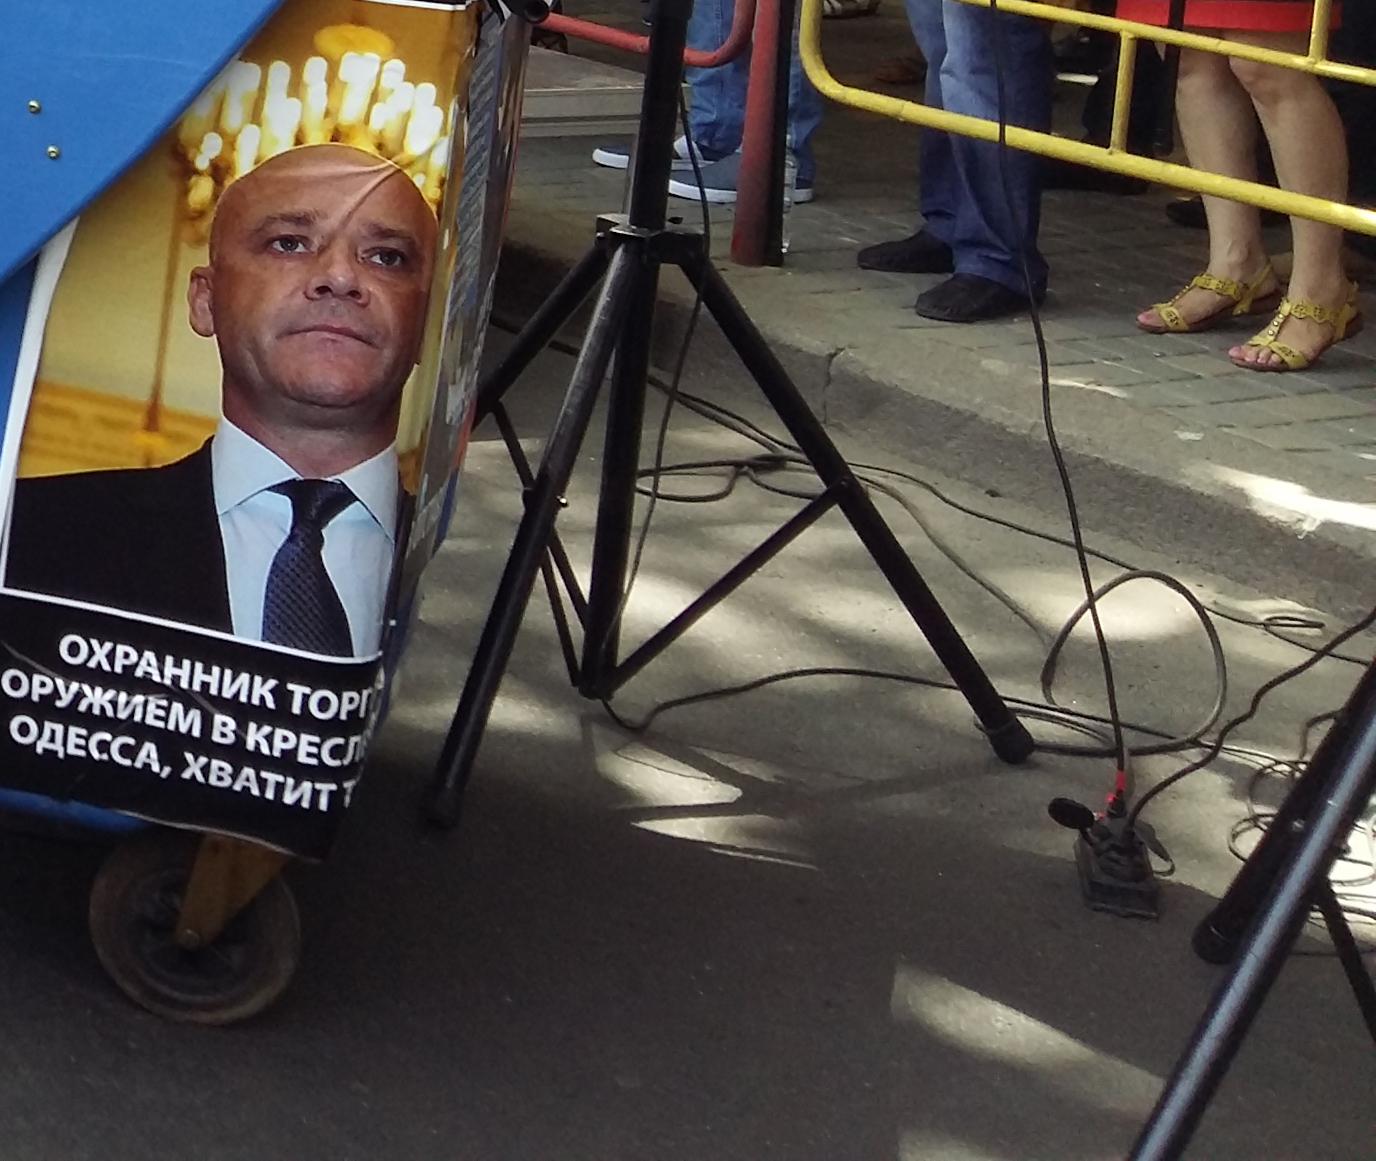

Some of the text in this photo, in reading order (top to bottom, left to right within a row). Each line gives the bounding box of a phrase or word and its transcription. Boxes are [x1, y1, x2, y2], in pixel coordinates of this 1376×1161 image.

[0, 668, 203, 739] ОРУЖИЕМ
[211, 713, 238, 746] В
[58, 633, 374, 721] ОХРАННИК ТОРГ
[8, 714, 172, 779] ОДЕССА,
[181, 752, 339, 813] ХВАТИТ
